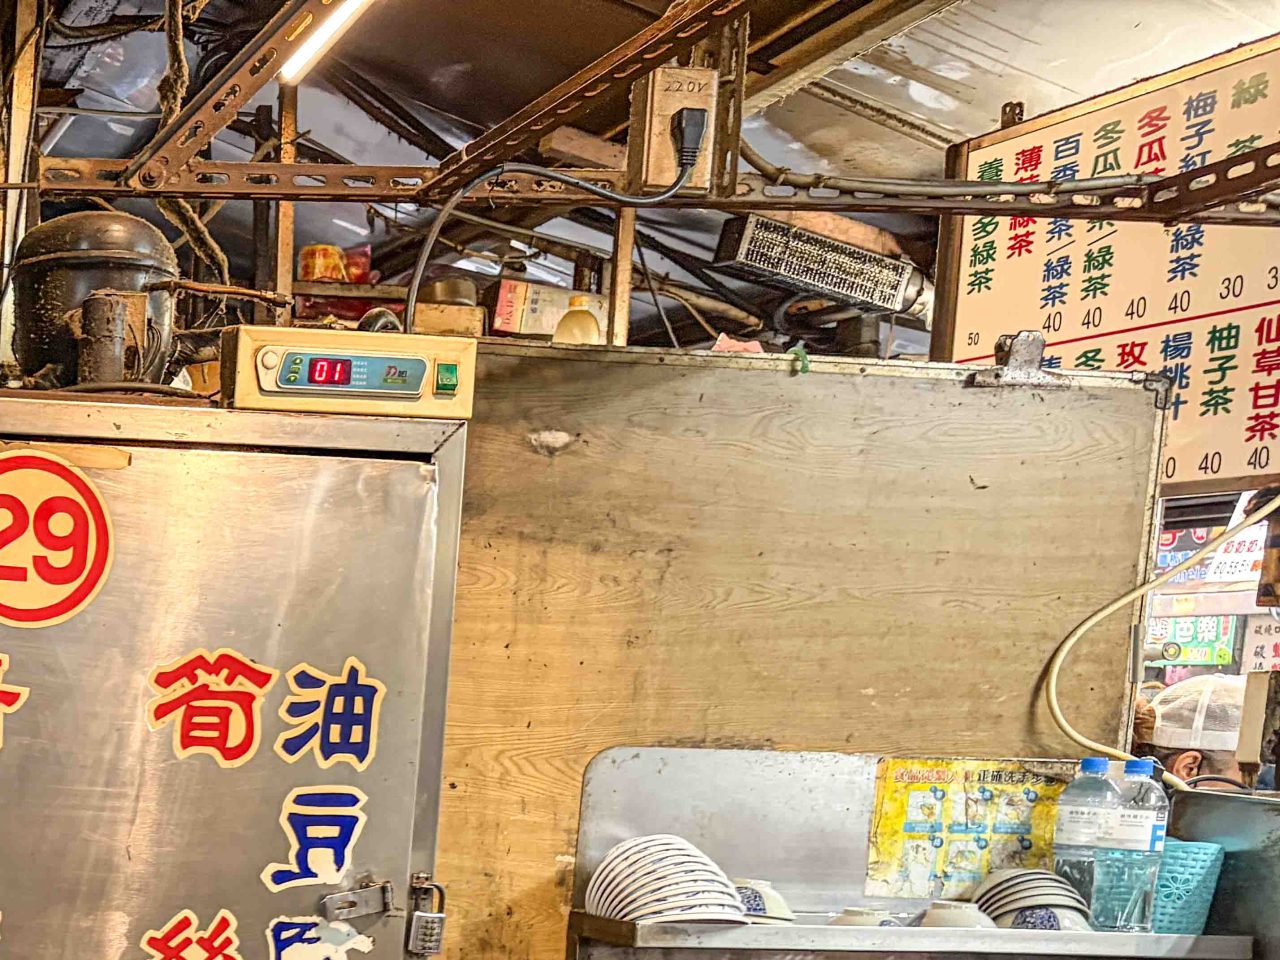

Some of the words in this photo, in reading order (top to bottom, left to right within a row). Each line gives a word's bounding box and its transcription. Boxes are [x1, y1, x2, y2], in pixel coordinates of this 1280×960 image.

[1134, 105, 1171, 175] 冬瓜
[967, 158, 1004, 295] 養多綠茶
[1040, 132, 1083, 309] 百香茶/綠茶
[967, 332, 980, 346] 50
[1042, 311, 1062, 333] 40
[1081, 306, 1103, 329] 40
[1125, 296, 1147, 320] 40
[1168, 290, 1191, 314] 40
[1219, 275, 1244, 299] 30
[314, 361, 343, 382] 01
[1199, 322, 1241, 417] 柚子茶
[1164, 456, 1177, 479] 0
[1198, 451, 1222, 474] 40
[1247, 446, 1270, 469] 40
